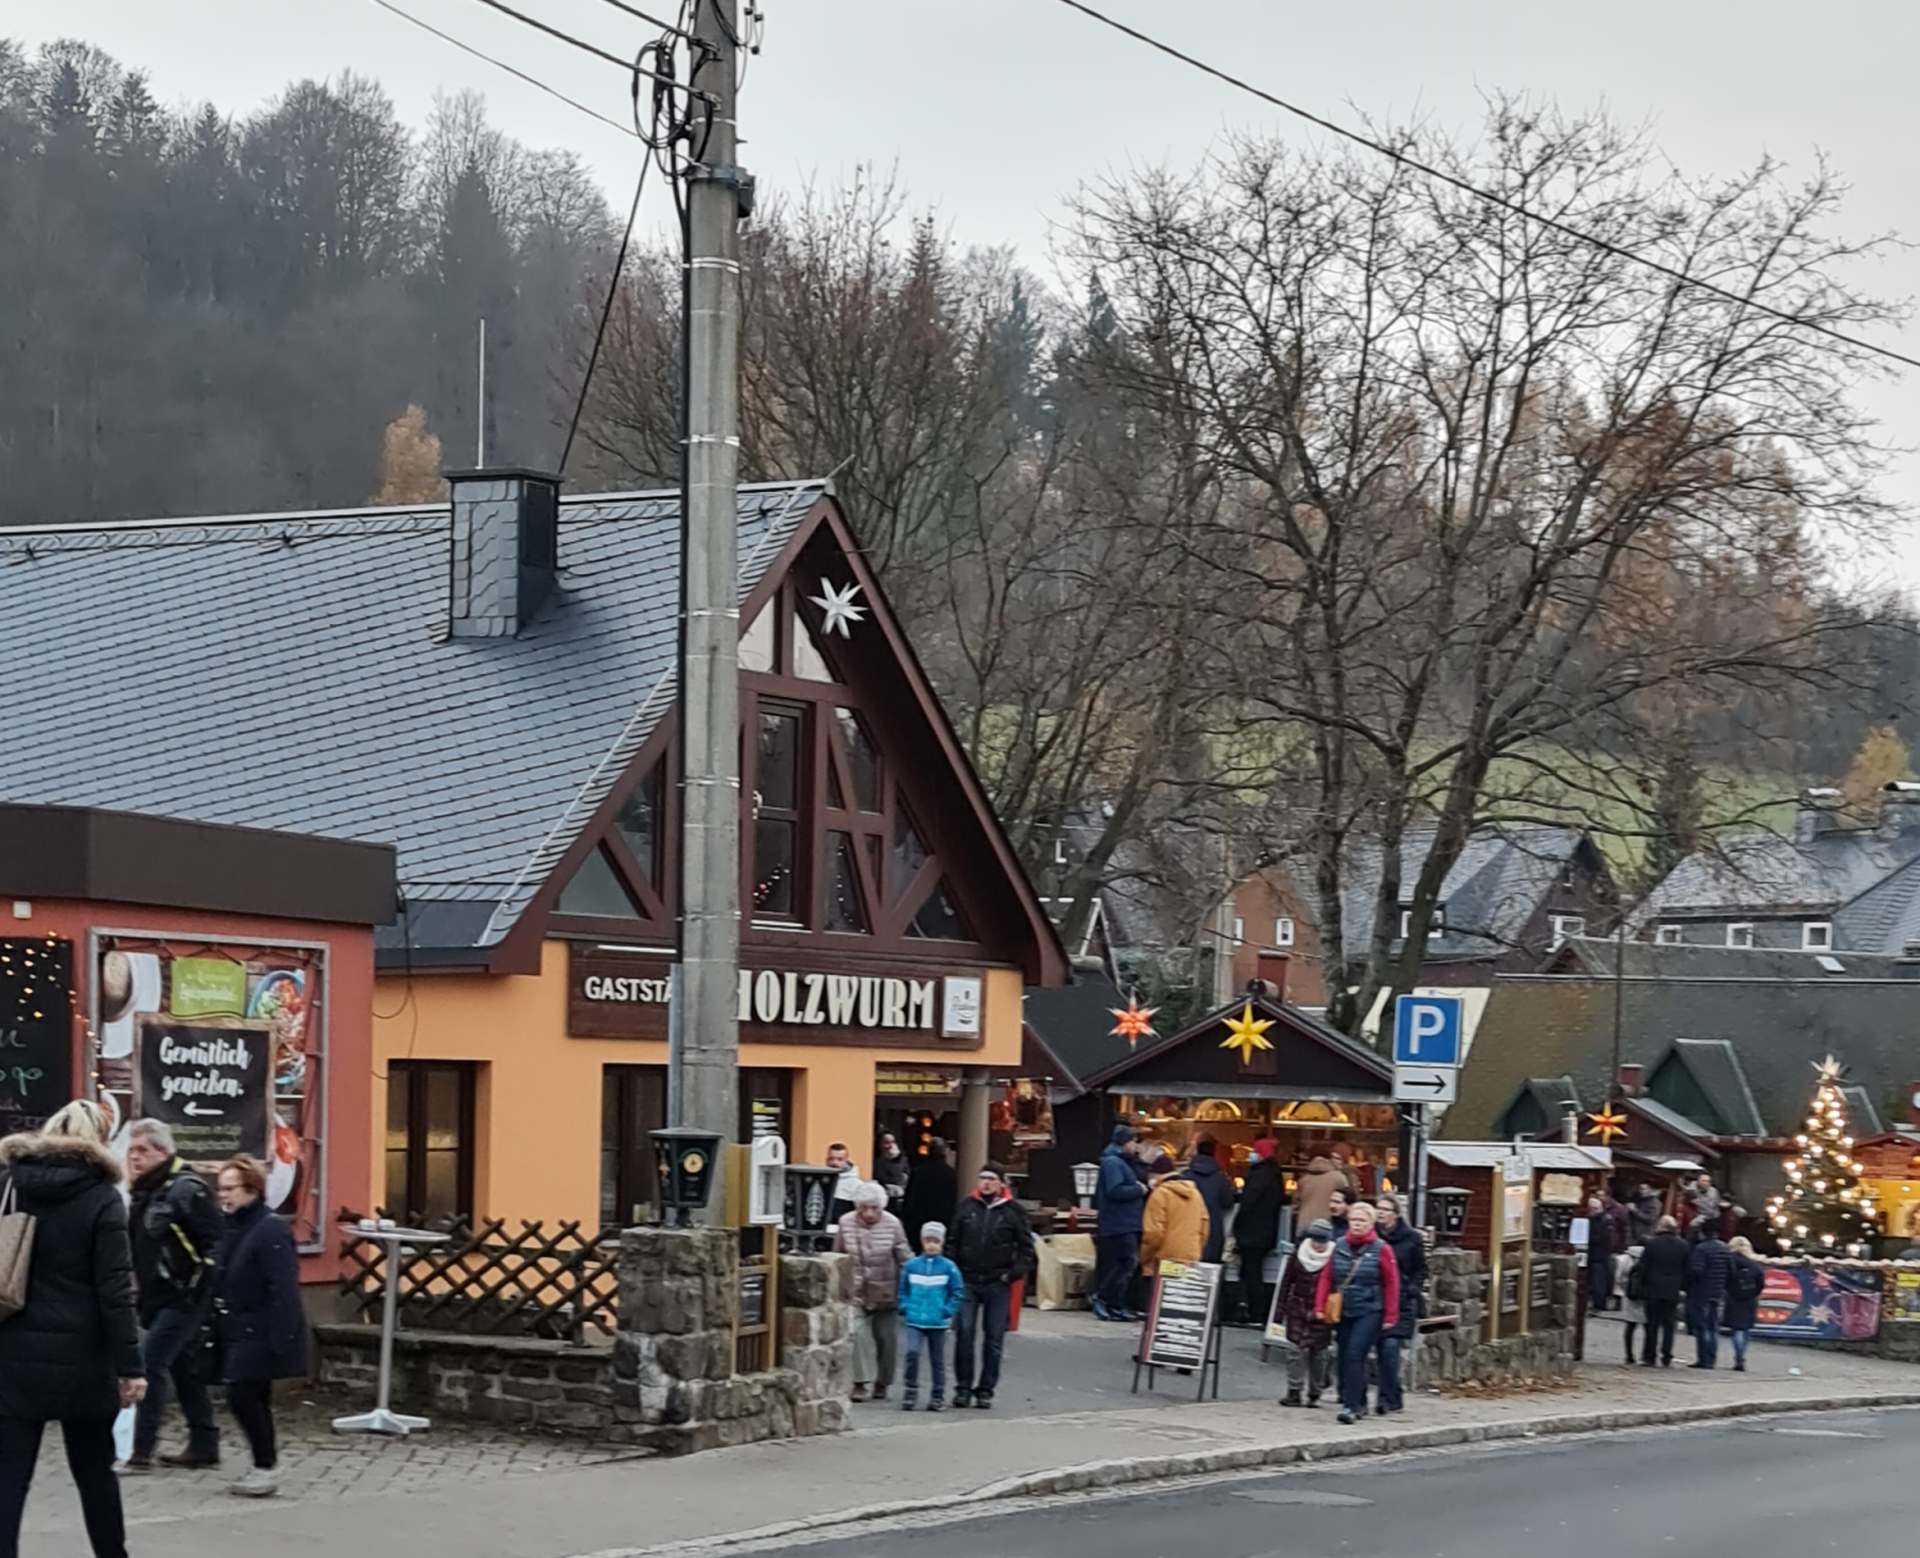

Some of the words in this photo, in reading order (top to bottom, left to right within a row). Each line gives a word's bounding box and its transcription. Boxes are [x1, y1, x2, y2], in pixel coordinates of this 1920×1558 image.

[585, 975, 673, 1003] GASTSTÄ
[1409, 1004, 1447, 1055] P
[160, 1036, 250, 1070] Gemütlich
